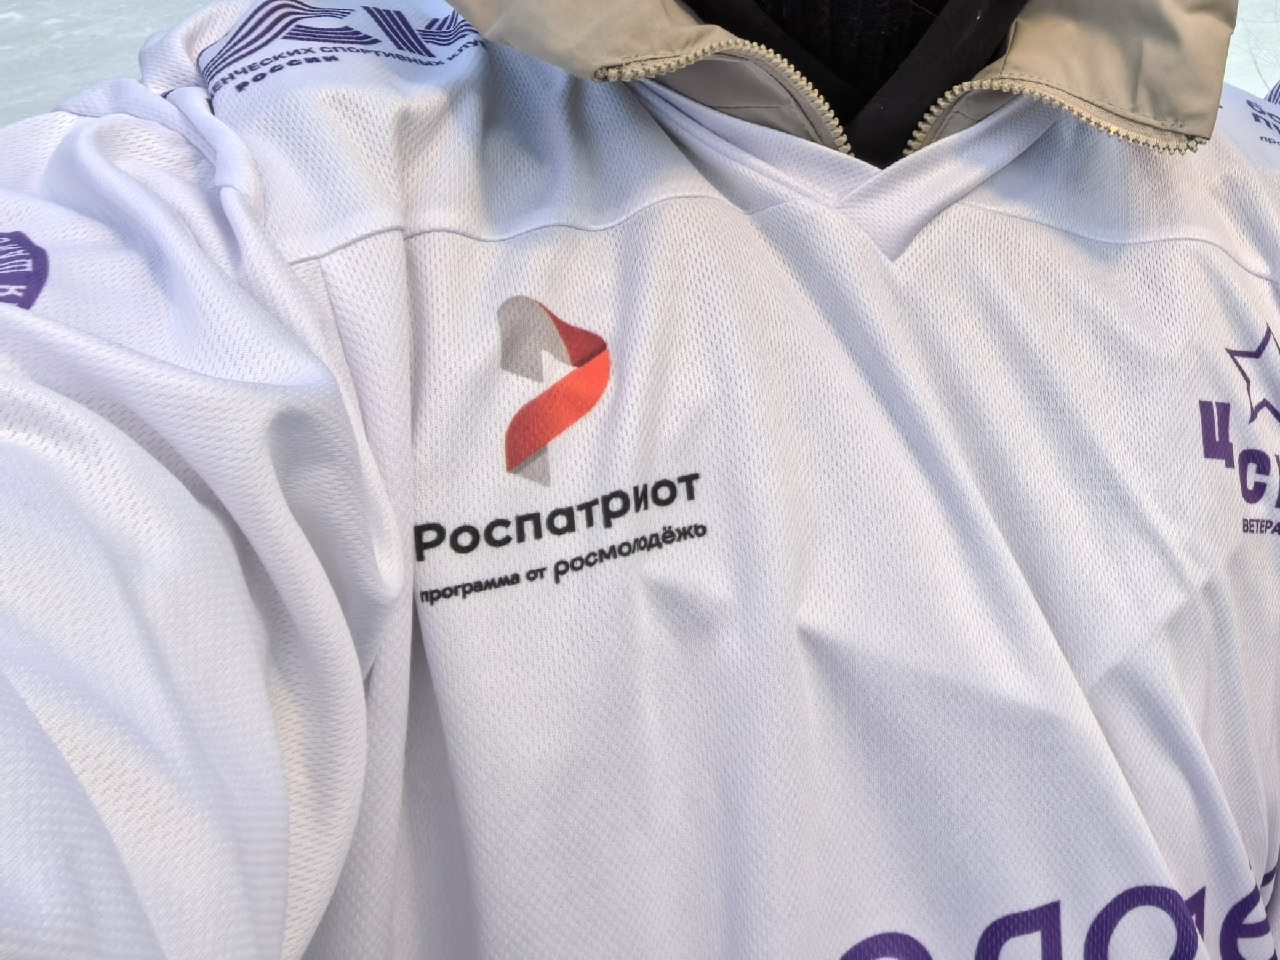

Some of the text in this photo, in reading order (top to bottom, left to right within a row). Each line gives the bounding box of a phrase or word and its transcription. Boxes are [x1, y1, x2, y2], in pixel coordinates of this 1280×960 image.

[209, 45, 315, 99] ЕНЧЕСКИХ
[234, 52, 340, 93] РОССИИ
[413, 472, 700, 562] Роспатриот
[419, 523, 708, 605] программа от росмолодёжь
